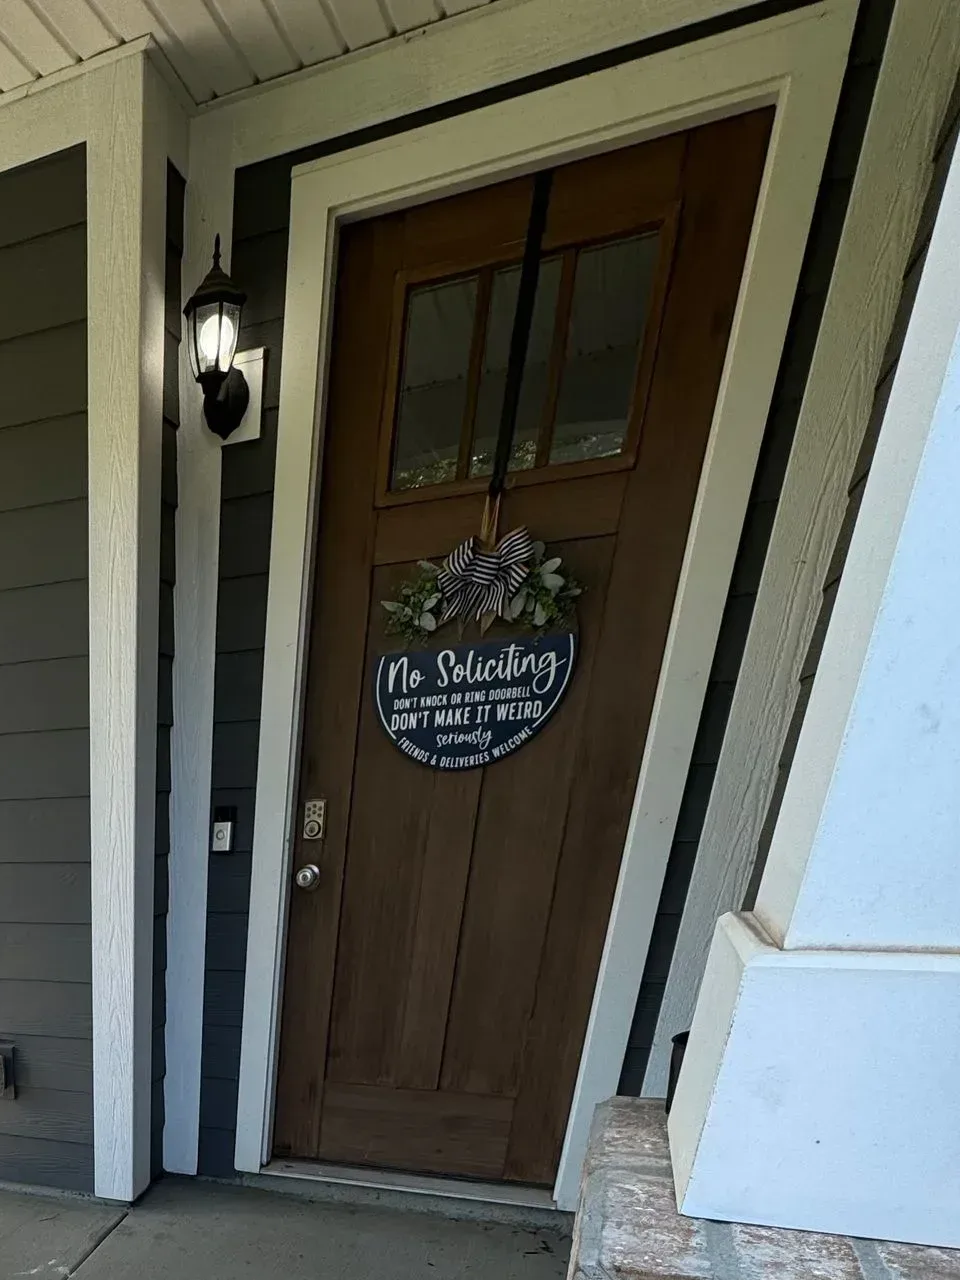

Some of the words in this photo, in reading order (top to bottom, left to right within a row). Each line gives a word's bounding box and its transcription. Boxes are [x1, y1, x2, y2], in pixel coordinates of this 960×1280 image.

[388, 657, 425, 693] No
[437, 643, 567, 694] Soliciting
[393, 697, 418, 710] DON'T
[420, 695, 448, 708] KNOCK
[450, 693, 461, 705] OR
[464, 690, 485, 703] RING
[488, 685, 531, 701] DOORBELL
[391, 710, 430, 731] DON'T
[434, 707, 471, 727] MAKE
[475, 704, 491, 724] IT
[496, 700, 542, 722] WEIRD
[397, 736, 430, 763] FRIENDS
[430, 754, 438, 766] &
[440, 751, 490, 768] DELIVERIES
[492, 725, 533, 759] WELCOME
[436, 725, 493, 750] seriously
